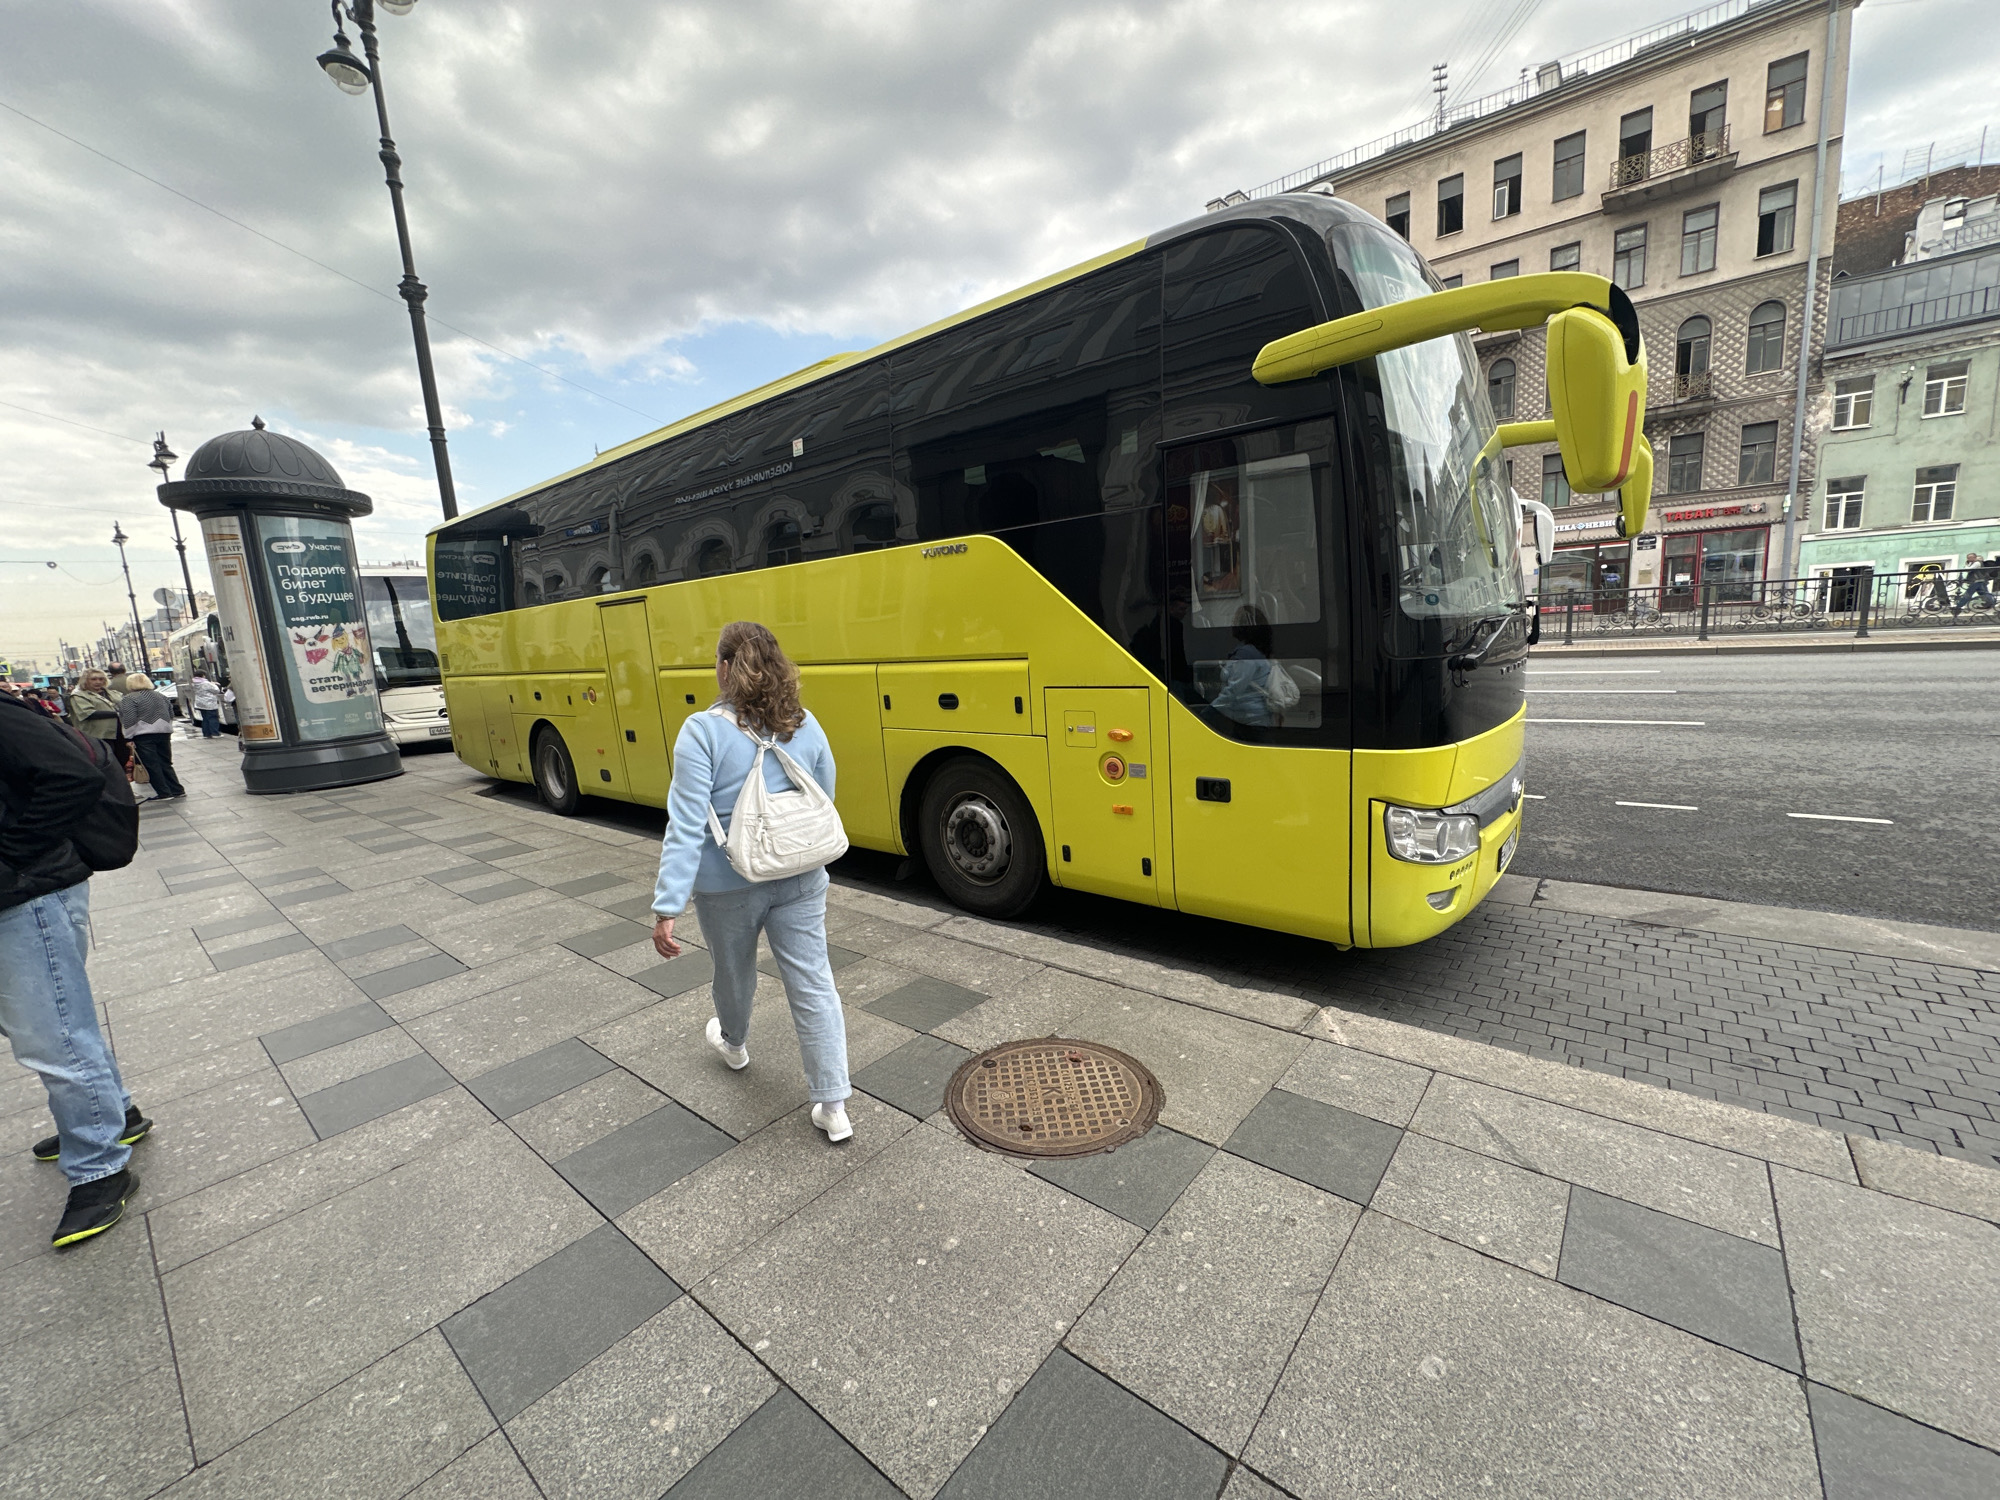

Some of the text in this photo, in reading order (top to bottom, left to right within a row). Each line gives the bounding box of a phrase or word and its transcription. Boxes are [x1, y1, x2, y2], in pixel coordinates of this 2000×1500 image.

[1665, 507, 1715, 523] ТАБАК
[1554, 524, 1577, 532] ТЕКА
[308, 543, 342, 551] Участие
[921, 543, 968, 558] YUTONG
[277, 565, 346, 577] Подарите
[281, 578, 326, 590] билет
[286, 591, 354, 605] в будущее
[290, 614, 329, 622] esg.rwb.ru
[309, 675, 344, 685] стать
